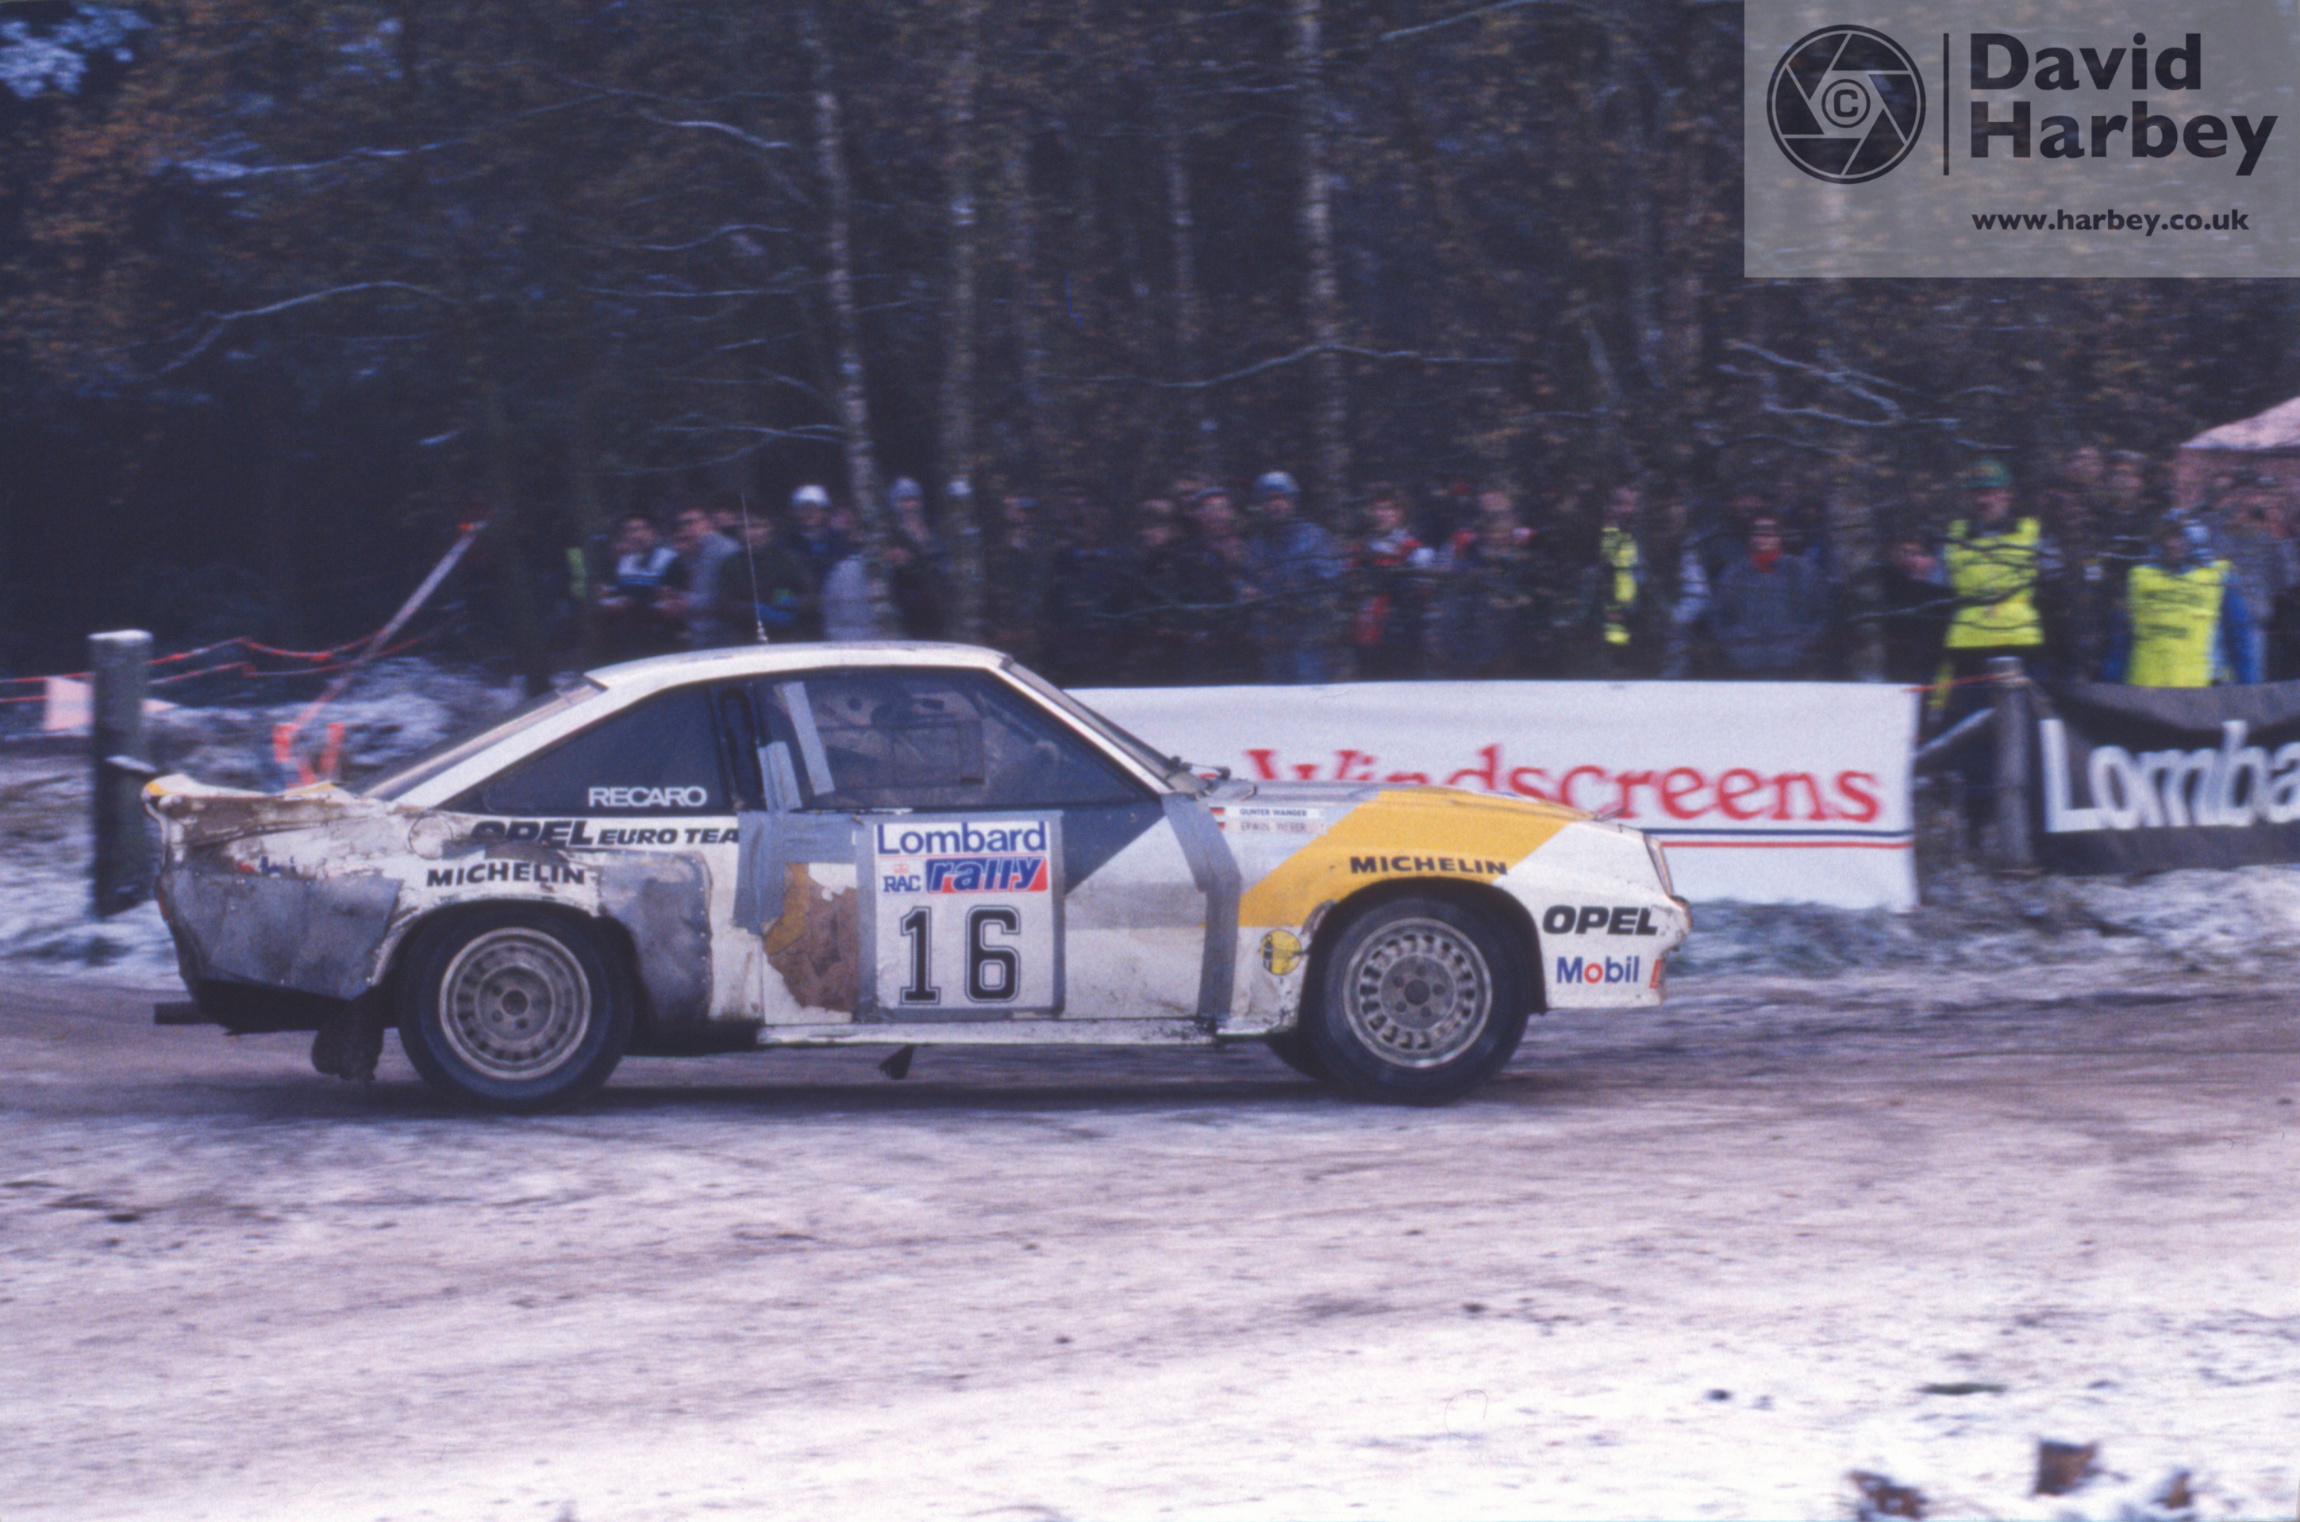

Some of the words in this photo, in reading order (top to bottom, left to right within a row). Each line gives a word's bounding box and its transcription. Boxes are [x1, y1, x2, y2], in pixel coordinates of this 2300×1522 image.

[588, 786, 707, 807] RECARO
[1247, 743, 1877, 823] dscreens
[470, 820, 593, 846] OPEL
[599, 828, 678, 845] EURO
[877, 821, 1046, 855] Lombard
[426, 862, 585, 887] MICHELIN
[883, 874, 921, 893] RAC
[929, 857, 1044, 892] rally
[1350, 856, 1508, 875] MICHELIN
[1542, 904, 1658, 936] OPEL
[900, 904, 1021, 1005] 16
[1556, 955, 1640, 984] Mobil
